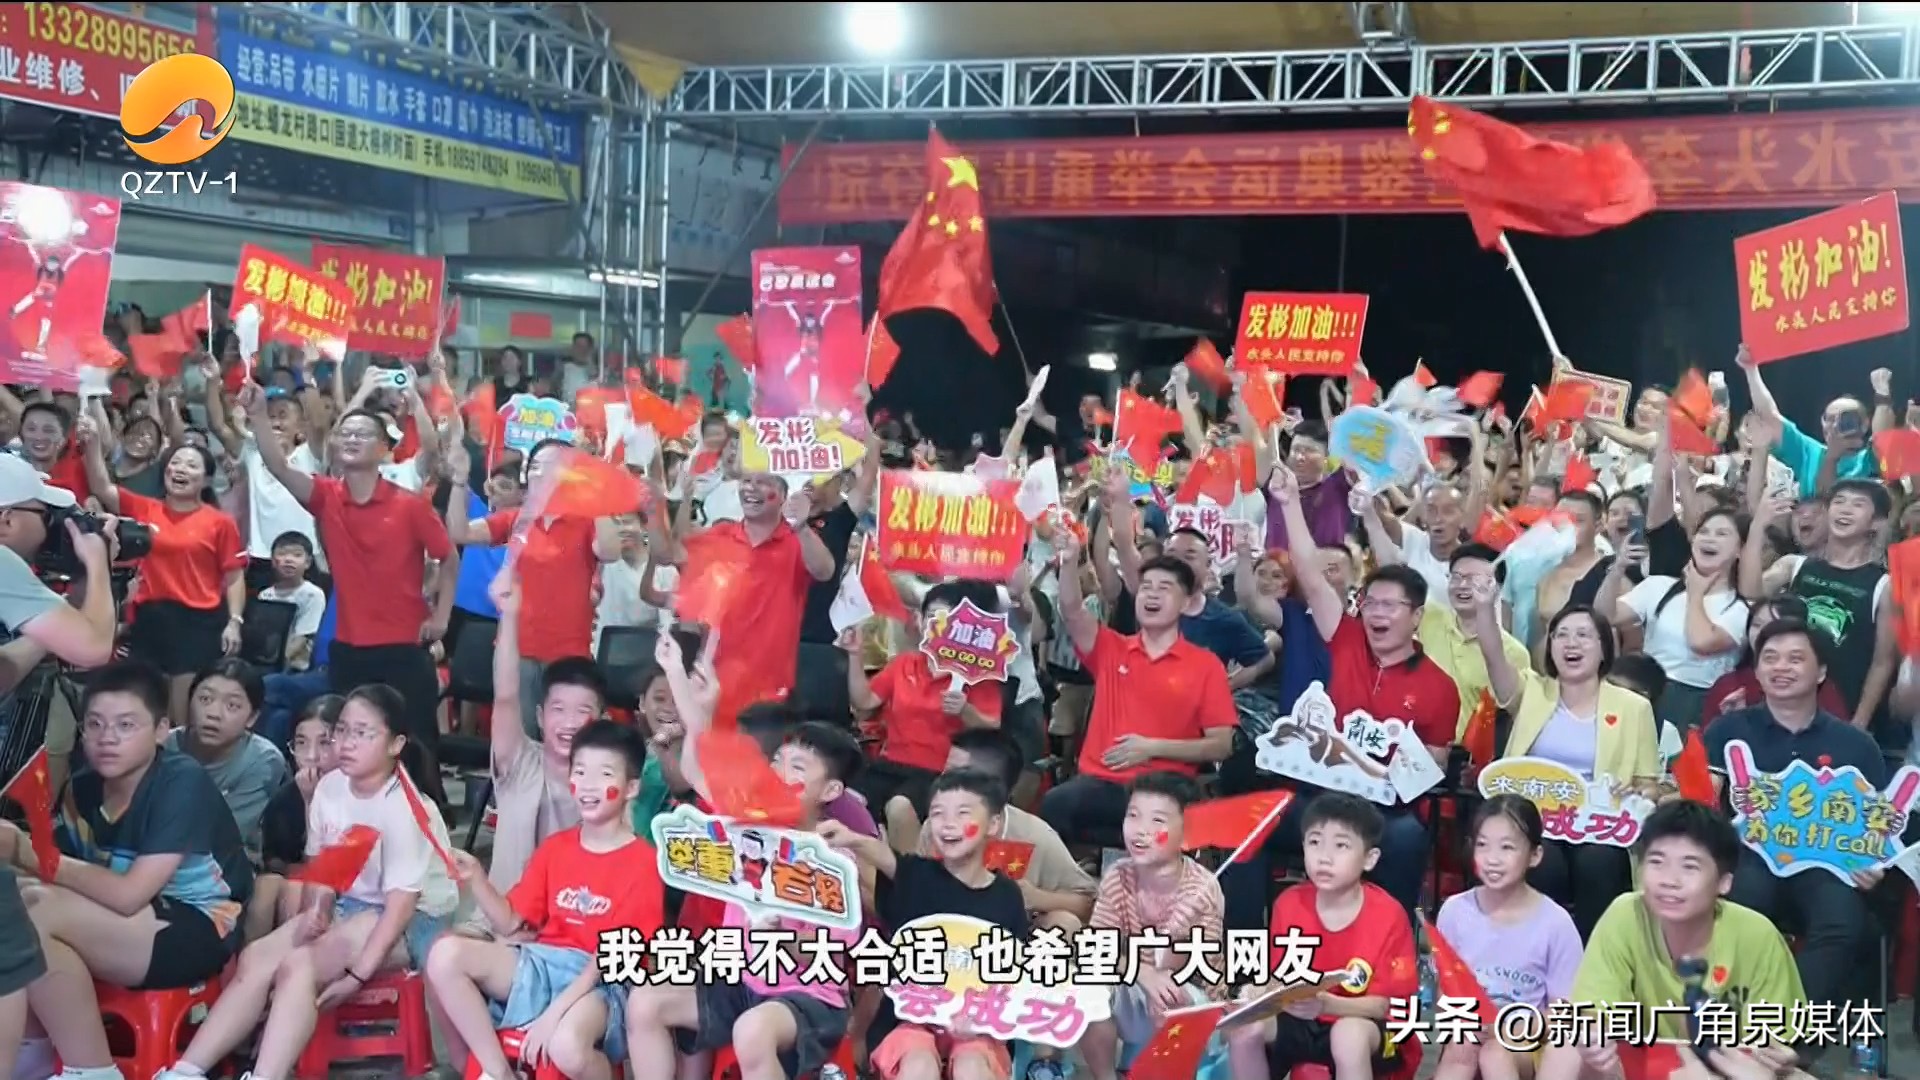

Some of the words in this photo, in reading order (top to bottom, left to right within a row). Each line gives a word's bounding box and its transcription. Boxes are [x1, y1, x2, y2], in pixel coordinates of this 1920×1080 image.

[1749, 219, 1891, 312] 发彬加油!
[1245, 303, 1358, 342] 发彬加油!!!
[1775, 286, 1897, 334] 水头人民支持你
[757, 419, 817, 446] 发彬
[769, 446, 842, 472] 加油!
[887, 485, 1017, 538] 发彬加油!!!
[947, 619, 997, 651] 加油
[1347, 715, 1387, 750] 南安
[1487, 774, 1581, 801] 来南安
